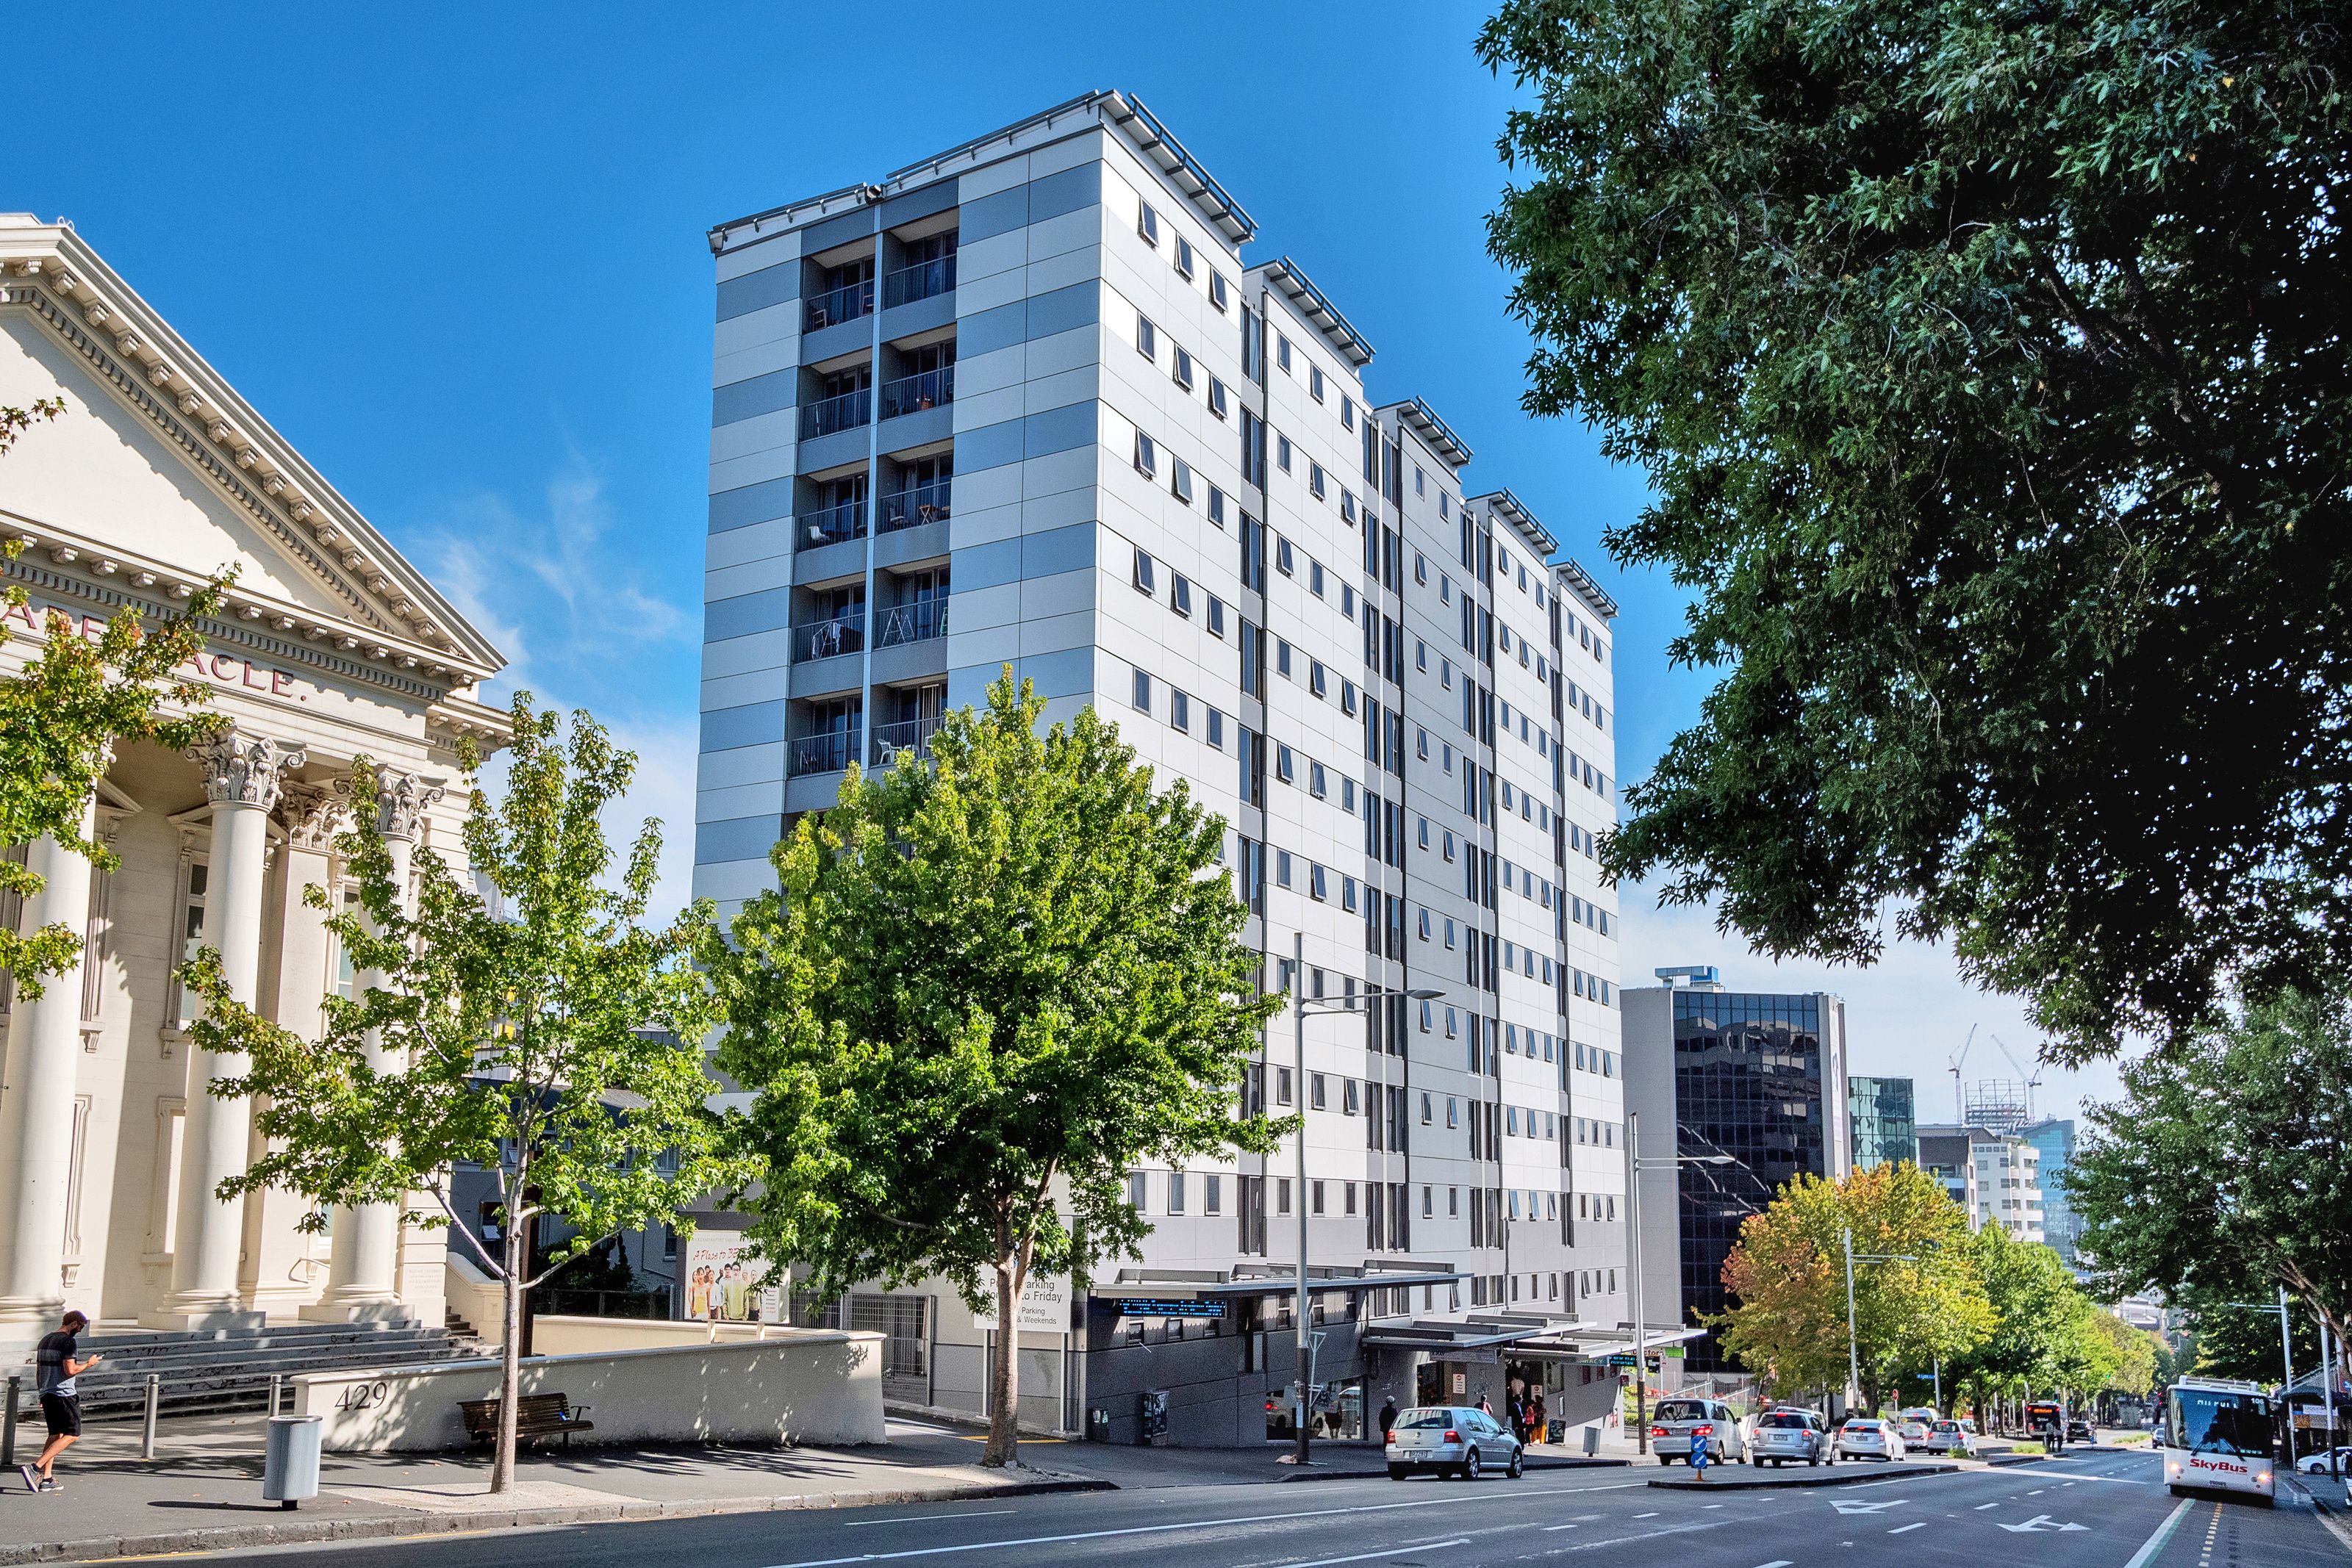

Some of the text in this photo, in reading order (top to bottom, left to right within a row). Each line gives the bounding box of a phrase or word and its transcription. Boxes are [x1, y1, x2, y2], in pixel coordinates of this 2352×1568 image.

[1025, 1280, 1055, 1292] arking
[1033, 1291, 1062, 1303] Friday
[1022, 1306, 1045, 1316] Parking
[1024, 1316, 1057, 1324] Weekends
[334, 1381, 388, 1411] 429
[2189, 1459, 2248, 1473] SkyBus
